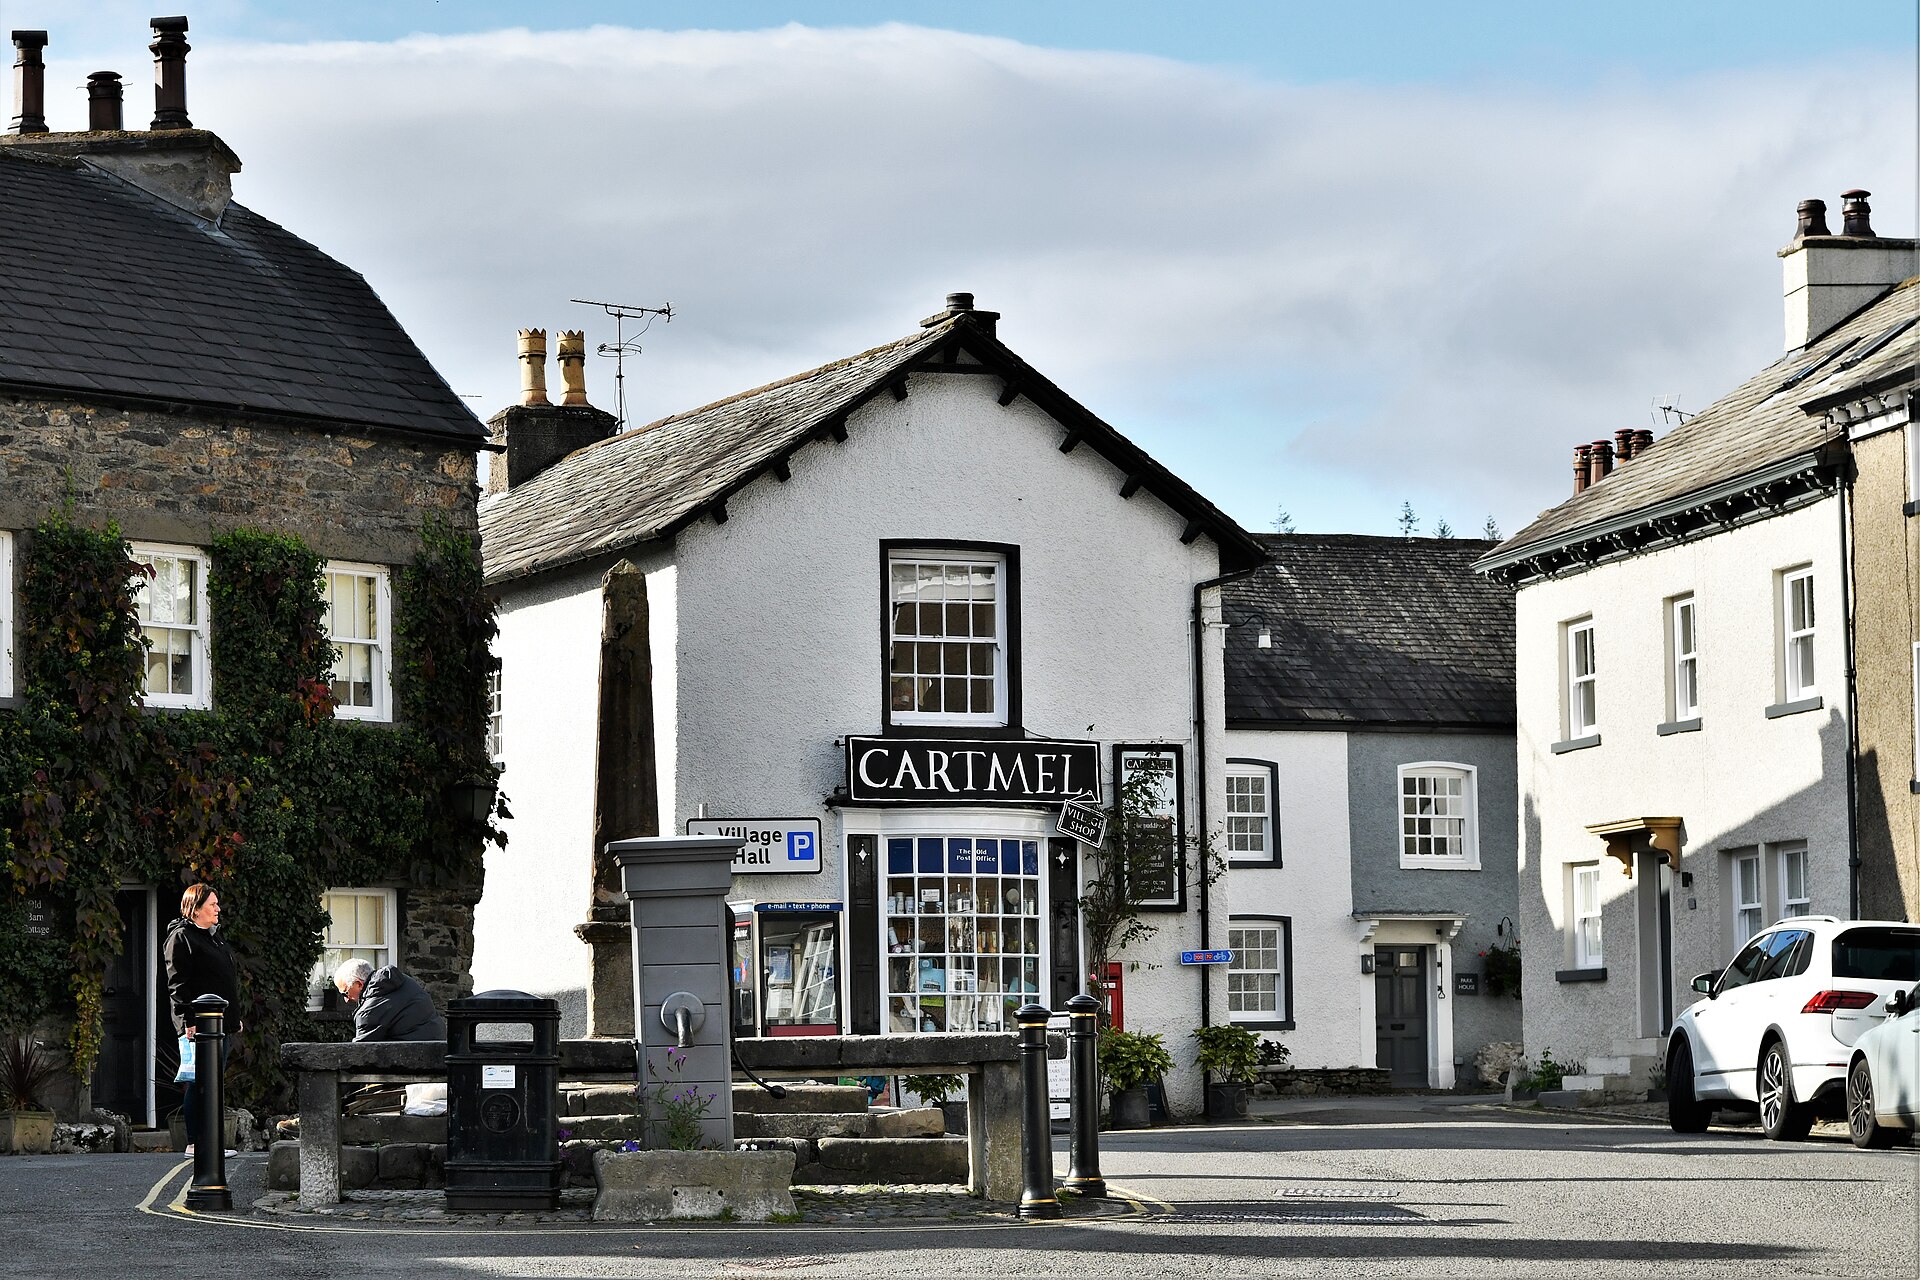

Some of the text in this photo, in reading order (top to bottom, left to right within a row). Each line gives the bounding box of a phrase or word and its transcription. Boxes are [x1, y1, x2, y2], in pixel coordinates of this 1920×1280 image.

[859, 748, 1083, 795] CARTMEL
[1067, 806, 1103, 829] VILLGE
[717, 826, 783, 846] Village
[1069, 820, 1096, 837] SHOP
[733, 847, 771, 865] Hall
[793, 834, 810, 858] P
